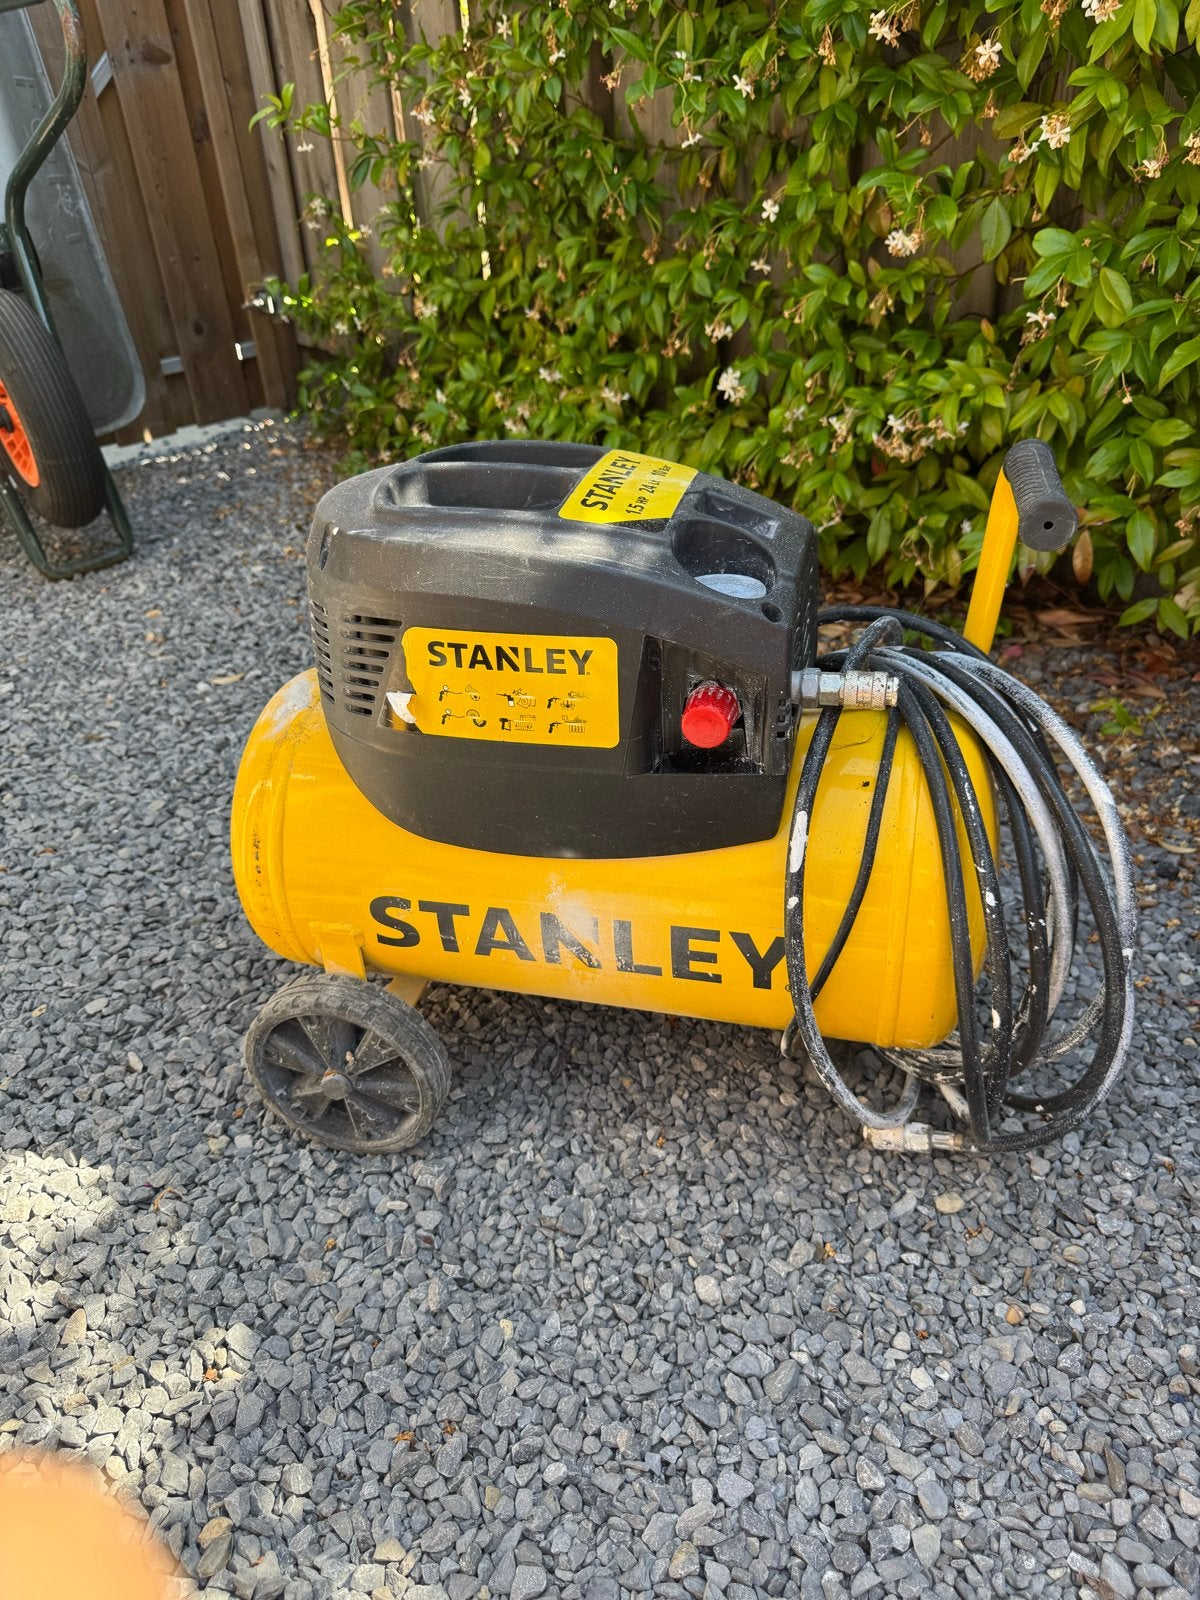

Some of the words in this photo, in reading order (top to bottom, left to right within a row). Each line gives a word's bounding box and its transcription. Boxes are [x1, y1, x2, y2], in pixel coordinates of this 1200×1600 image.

[580, 456, 641, 511] STANLEY
[427, 640, 594, 676] STANLEY
[369, 895, 786, 991] STANLEY
